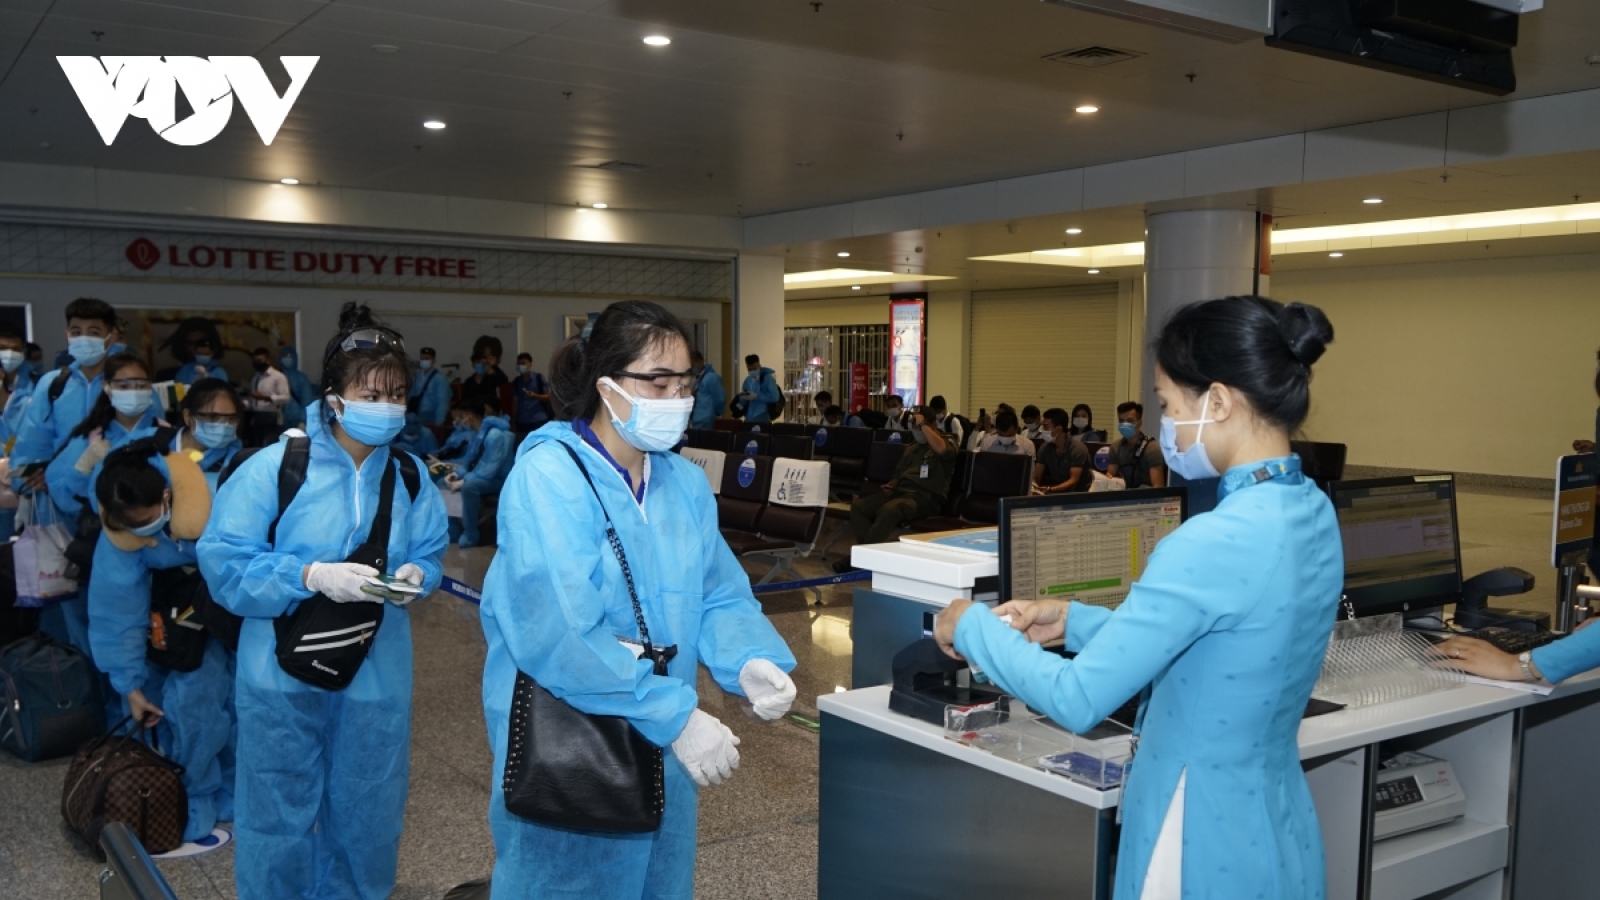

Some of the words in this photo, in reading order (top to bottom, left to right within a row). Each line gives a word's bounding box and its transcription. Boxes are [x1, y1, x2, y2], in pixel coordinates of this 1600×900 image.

[169, 245, 285, 270] LOTTE
[293, 252, 388, 275] DUTY
[395, 256, 476, 278] FREE
